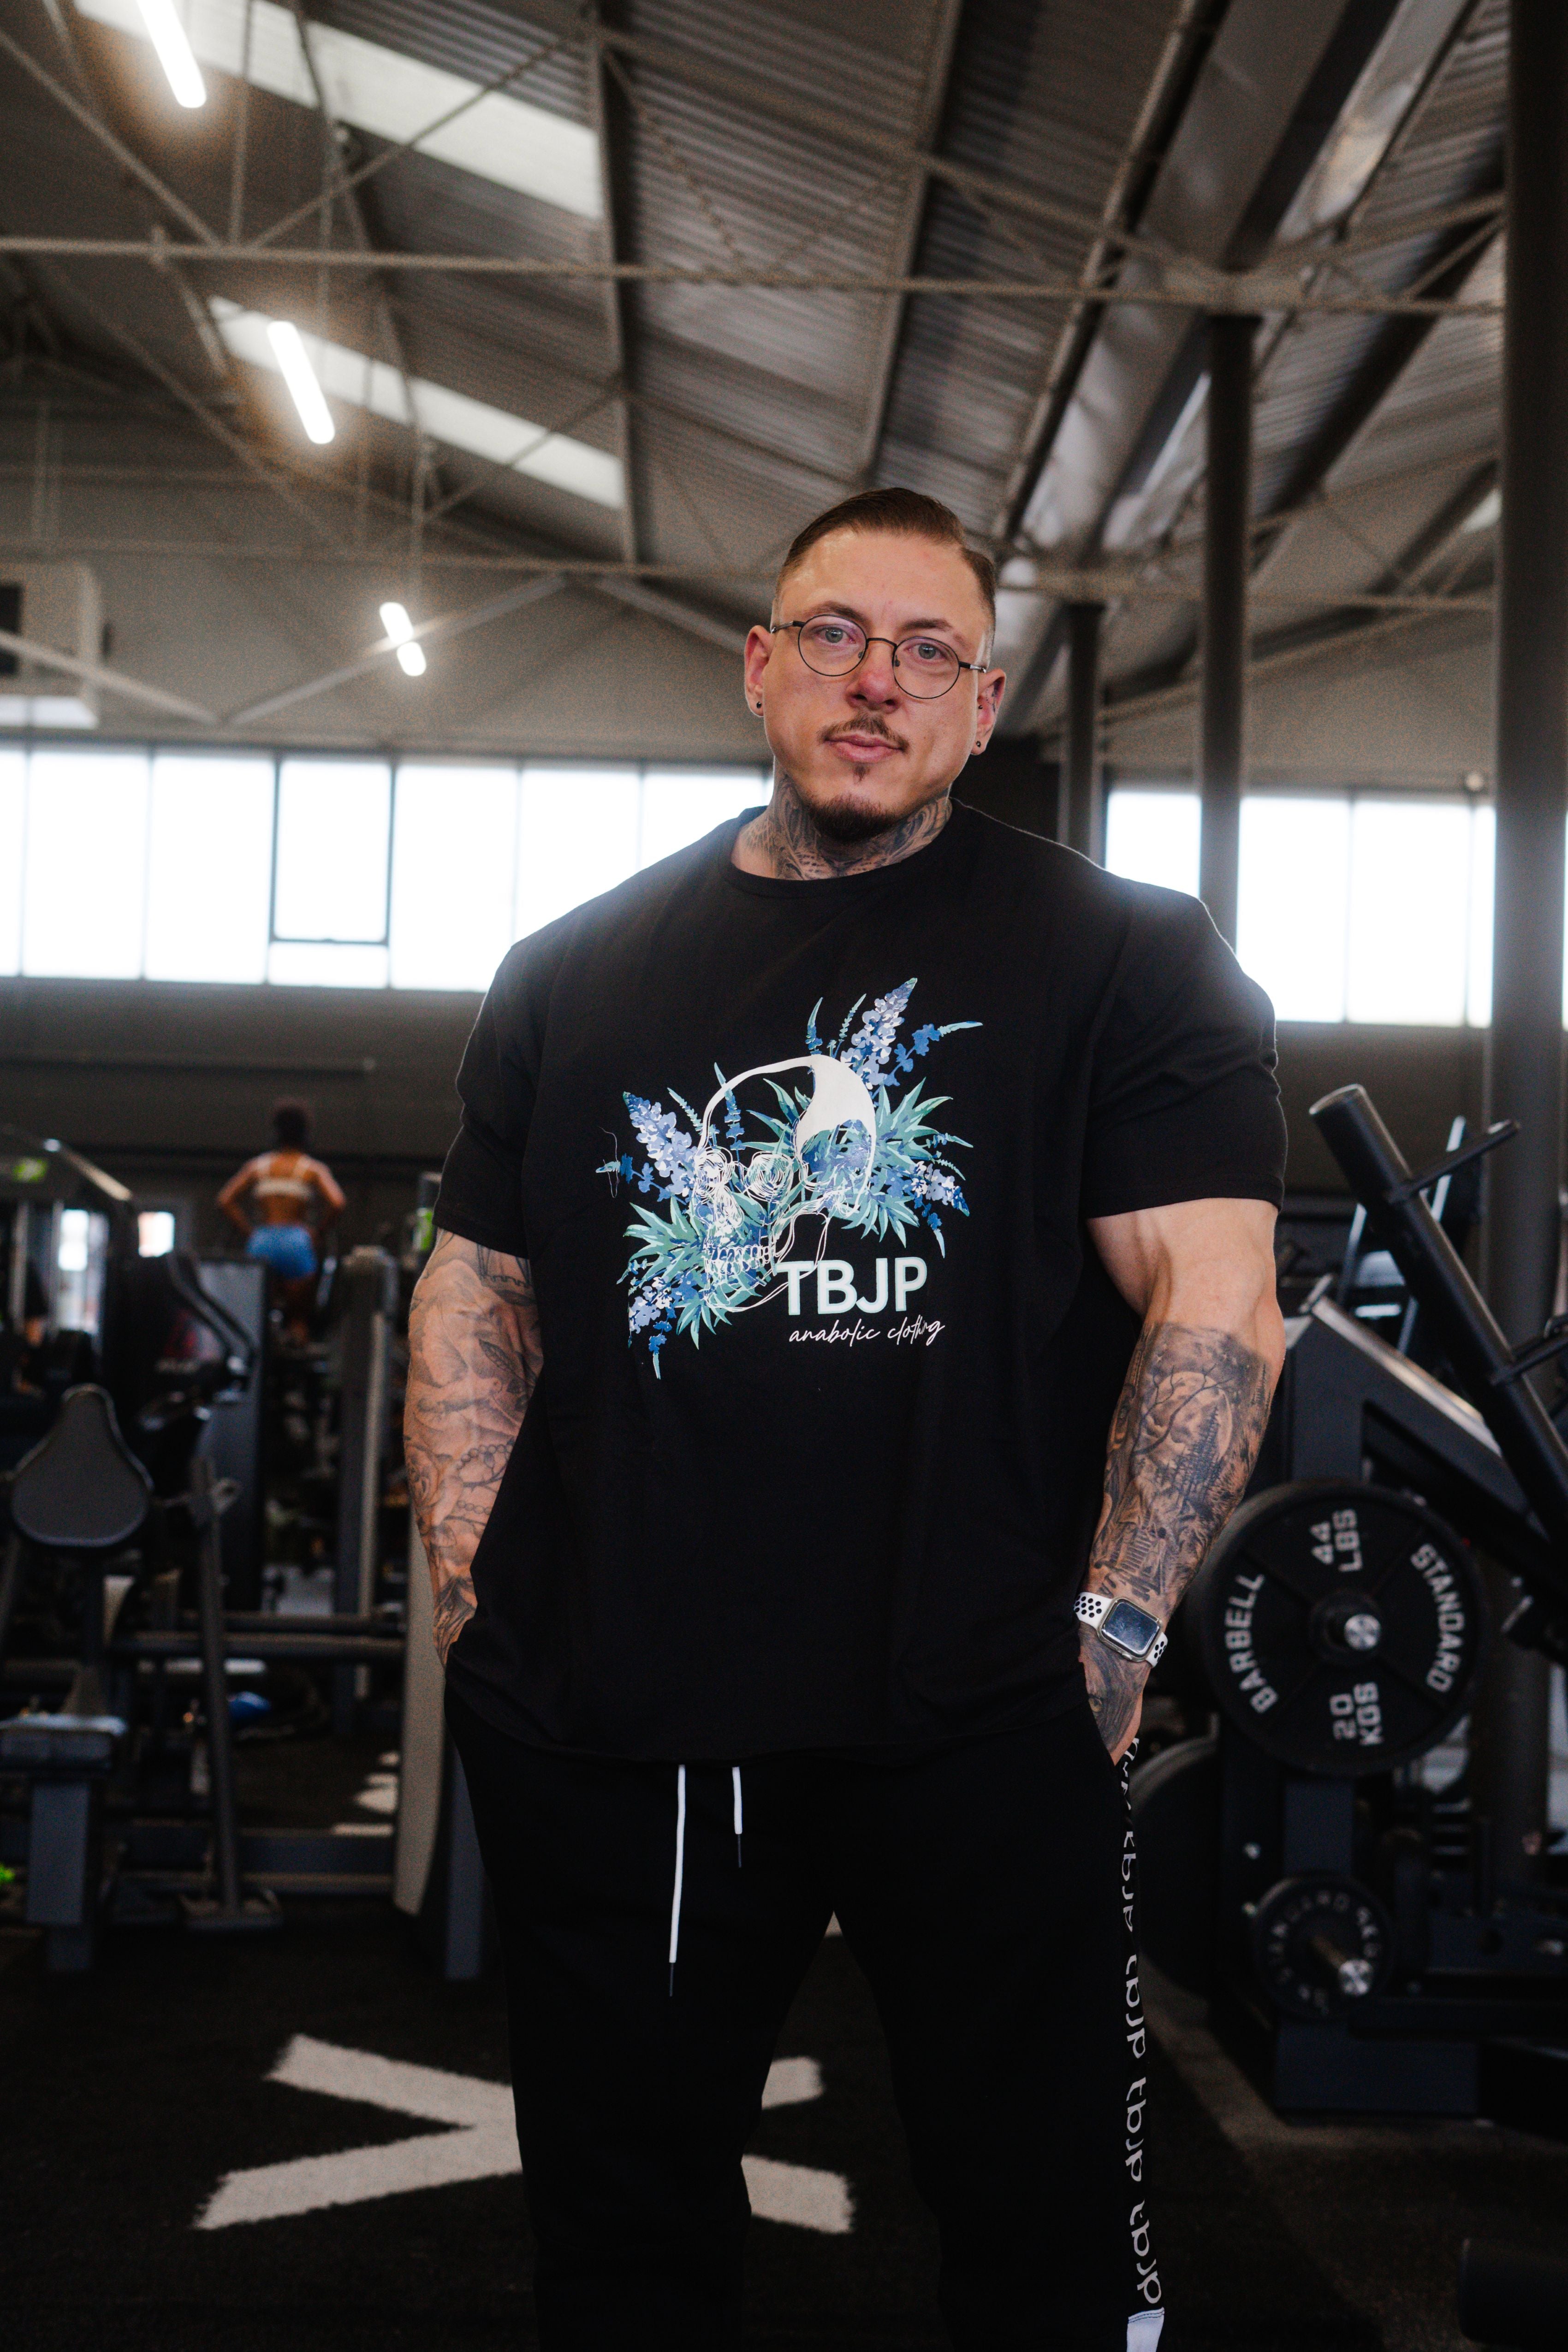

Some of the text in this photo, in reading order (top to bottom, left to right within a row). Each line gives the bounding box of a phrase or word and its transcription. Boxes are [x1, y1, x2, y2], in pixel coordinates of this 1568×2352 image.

[775, 1257, 927, 1315] TBJP
[789, 1319, 880, 1347] anabolic
[1310, 1522, 1334, 1565] 44
[1332, 1509, 1363, 1572] LBS
[1224, 1574, 1278, 1714] BARBELL
[1410, 1543, 1465, 1693] STANDARD
[1330, 1693, 1357, 1739] 20
[1353, 1682, 1383, 1746] KGS
